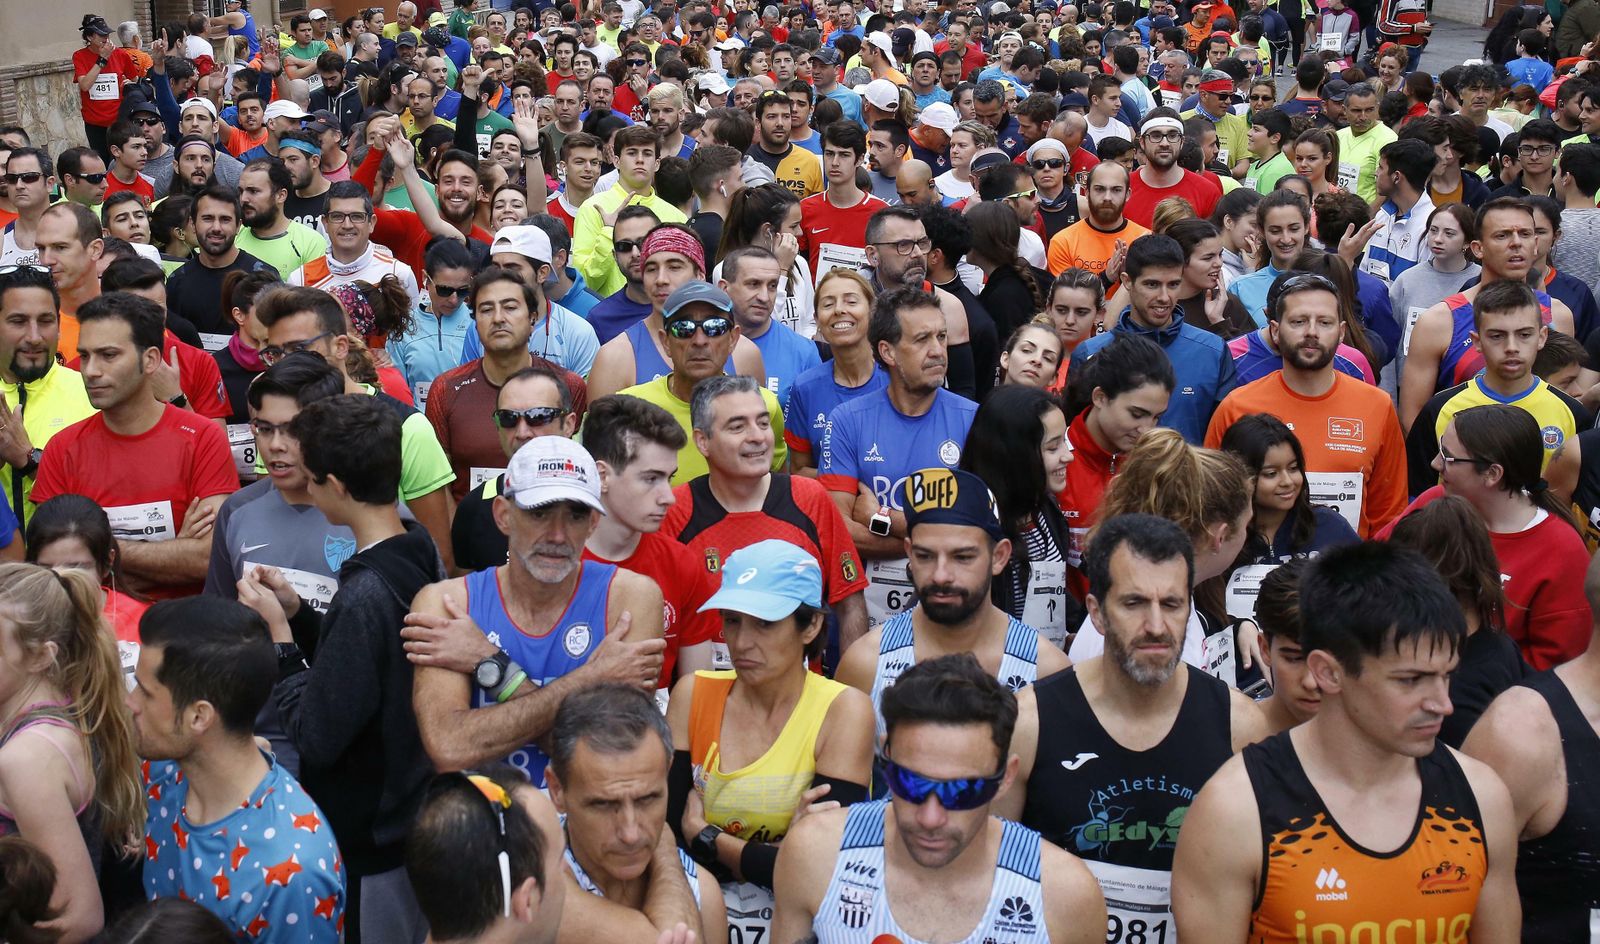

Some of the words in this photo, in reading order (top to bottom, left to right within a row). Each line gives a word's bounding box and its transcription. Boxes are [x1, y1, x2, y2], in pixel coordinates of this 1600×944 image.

[96, 84, 111, 92] 481
[823, 420, 833, 470] RCM1873
[538, 458, 587, 475] IRONMAN
[1315, 891, 1347, 901] mobel
